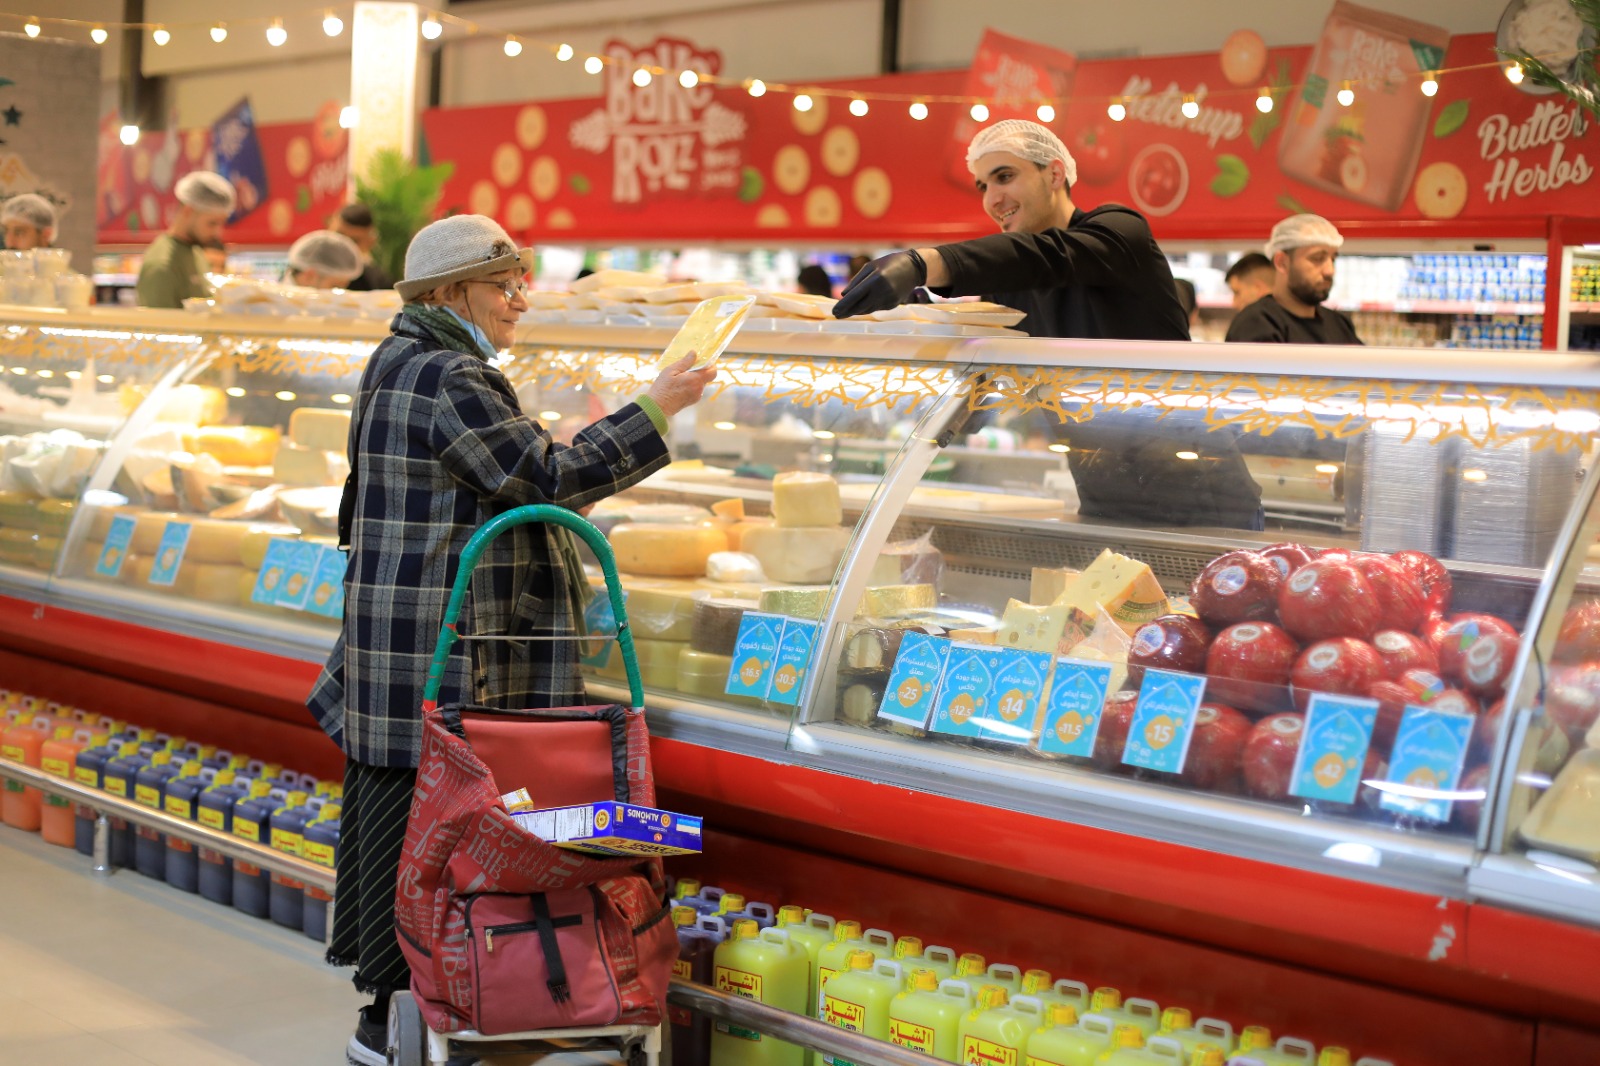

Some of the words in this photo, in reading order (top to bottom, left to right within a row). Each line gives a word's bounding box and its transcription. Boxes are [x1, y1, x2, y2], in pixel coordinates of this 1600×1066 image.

[1477, 100, 1588, 161] Butter
[1484, 142, 1594, 203] Herbs
[903, 686, 918, 700] 25
[954, 705, 972, 717] 12.5
[1005, 697, 1024, 716] 14
[1063, 723, 1082, 735] 11.5
[1153, 724, 1171, 743] 15
[627, 808, 659, 823] ALMONDS
[719, 971, 758, 991] الشام
[825, 1000, 862, 1022] الشام
[890, 1023, 931, 1044] الشام
[967, 1041, 1012, 1064] الشام
